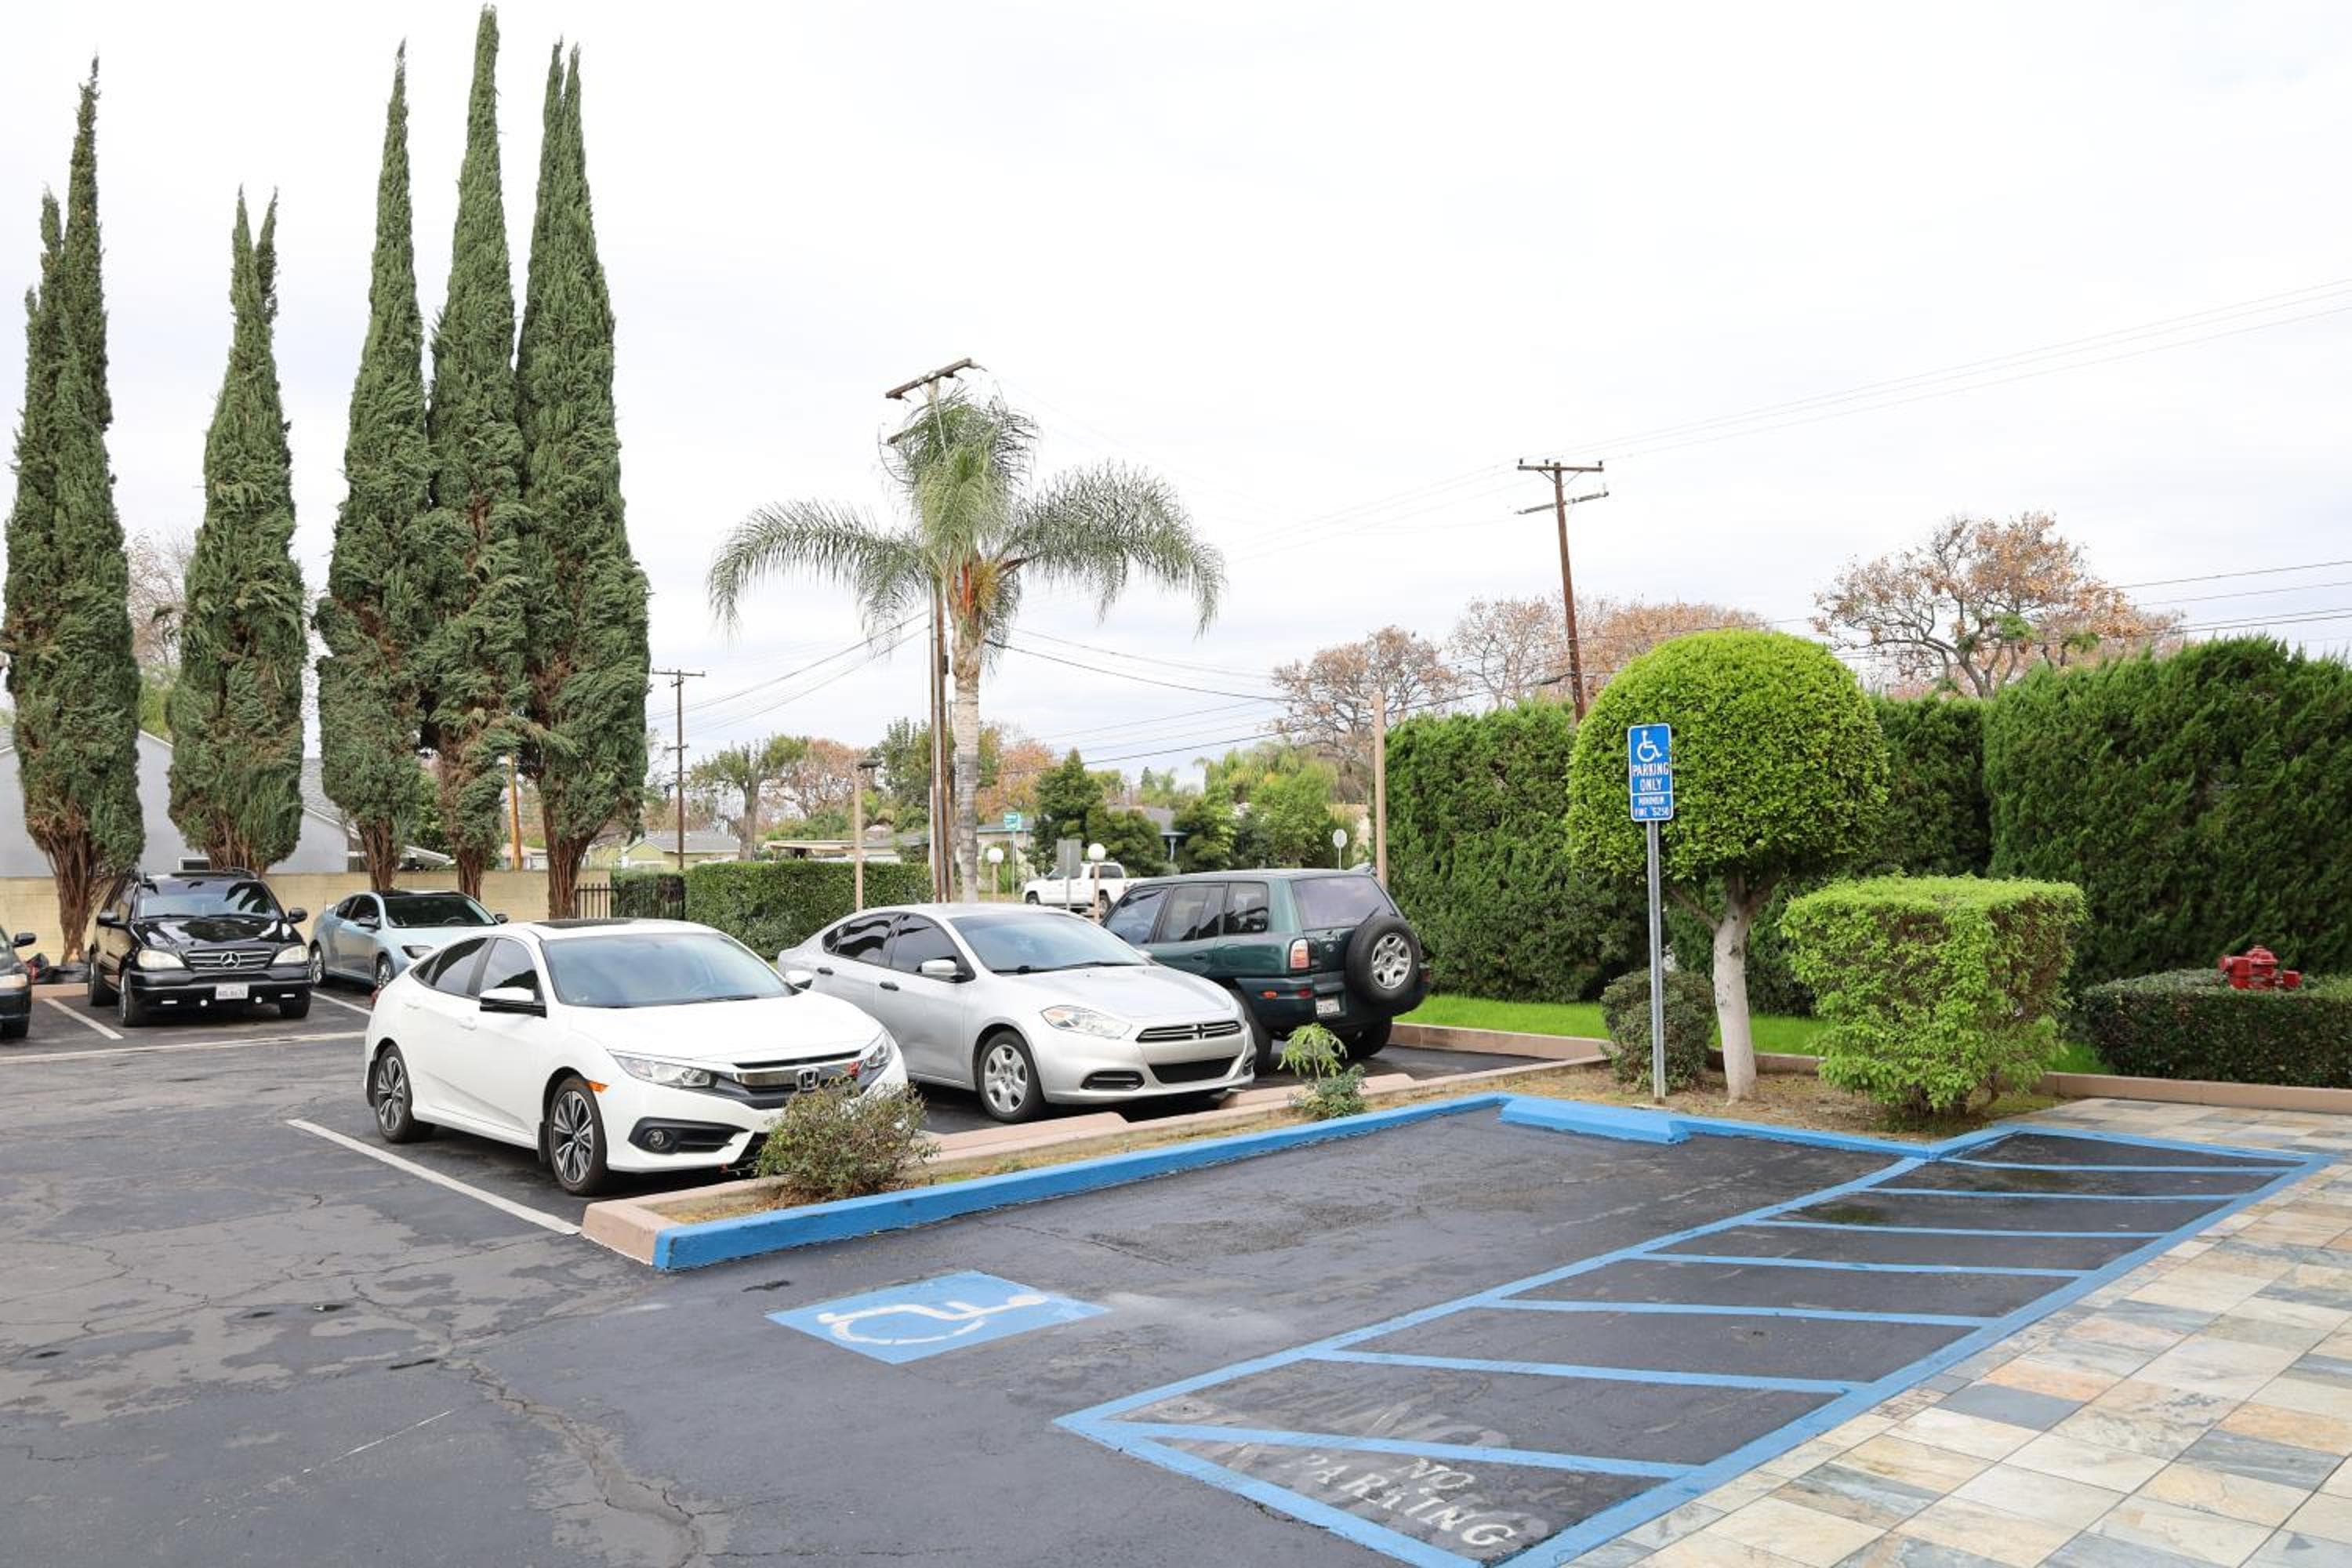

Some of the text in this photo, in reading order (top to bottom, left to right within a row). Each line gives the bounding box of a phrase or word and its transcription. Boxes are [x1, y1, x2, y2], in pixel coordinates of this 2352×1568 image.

[1632, 761, 1669, 777] PARKING
[1639, 777, 1663, 792] ONLY
[1391, 1457, 1475, 1490] NO
